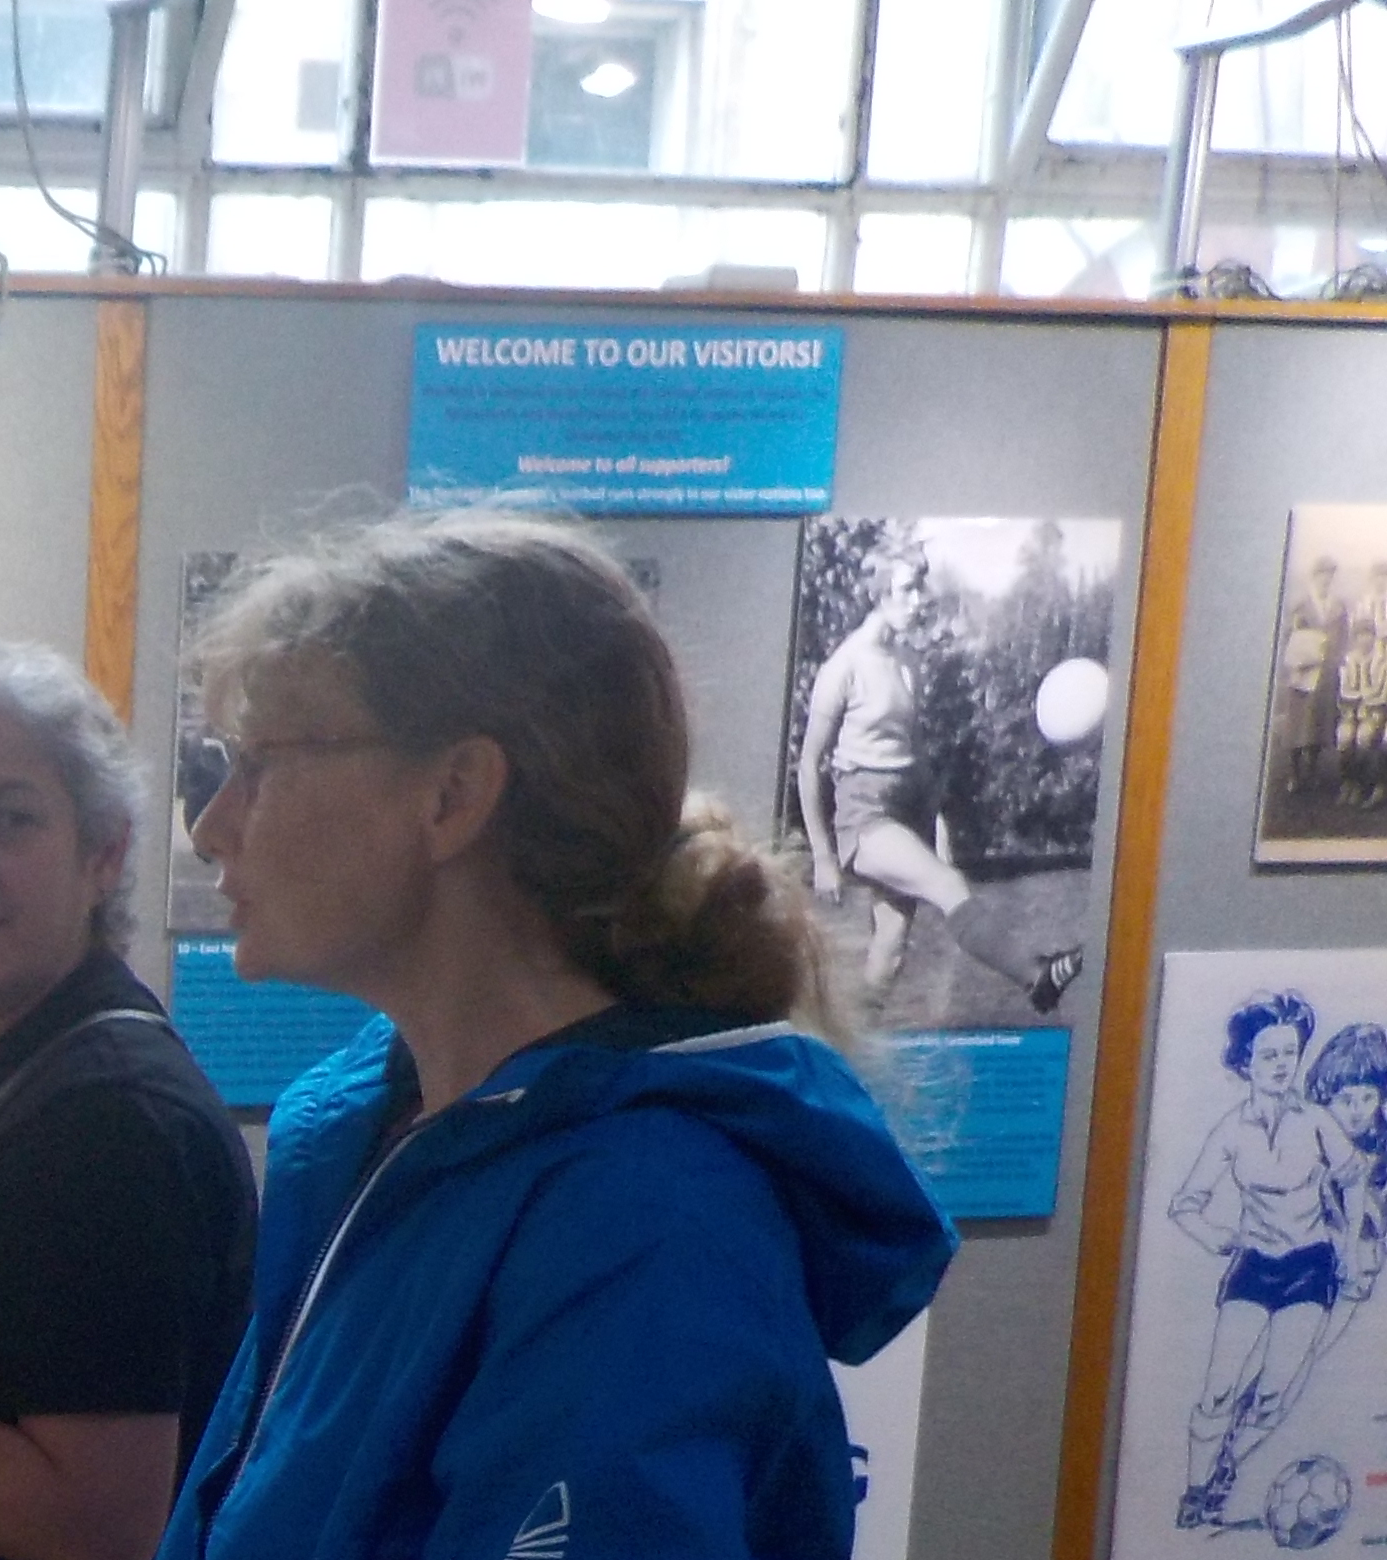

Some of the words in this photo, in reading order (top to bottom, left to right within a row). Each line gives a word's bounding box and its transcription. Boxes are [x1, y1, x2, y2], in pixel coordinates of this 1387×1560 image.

[436, 337, 575, 366] WELCOME
[583, 338, 622, 365] TO
[627, 338, 686, 366] OUR
[692, 338, 823, 368] VISITORS!
[518, 455, 591, 473] Welcome
[596, 456, 611, 472] to
[616, 454, 637, 472] all
